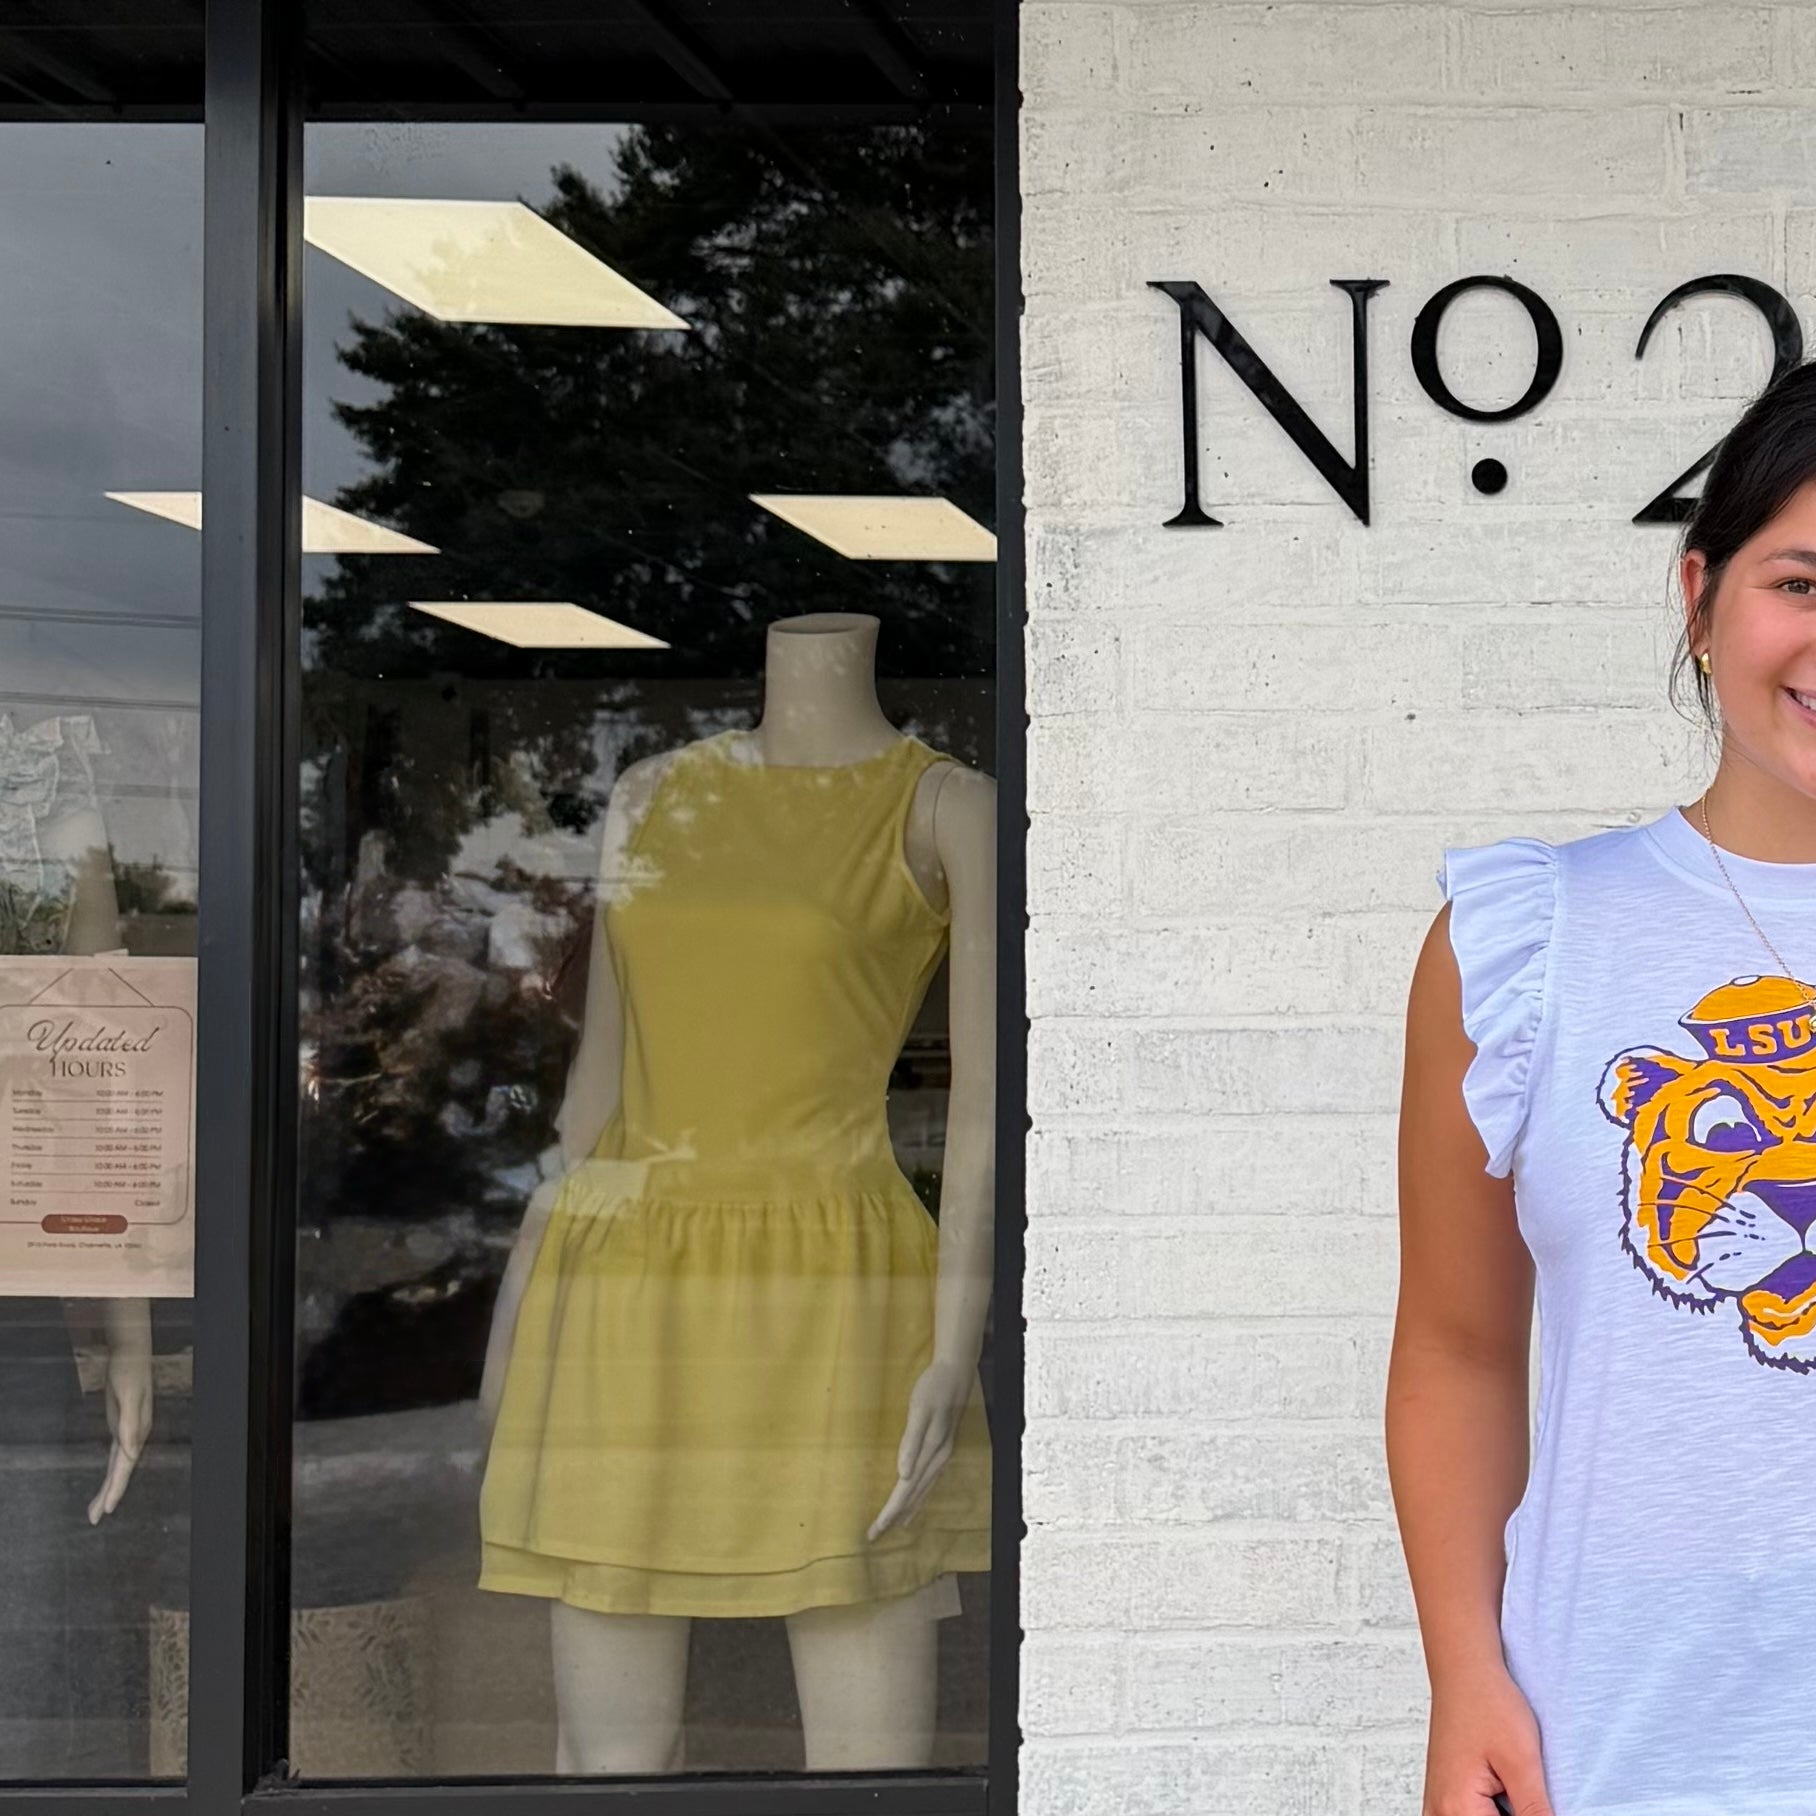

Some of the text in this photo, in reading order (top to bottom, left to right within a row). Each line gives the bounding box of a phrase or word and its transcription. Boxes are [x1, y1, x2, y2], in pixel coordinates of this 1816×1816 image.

[27, 1019, 161, 1063] Updated
[1708, 1013, 1812, 1057] LSU
[50, 1060, 127, 1078] HOURS
